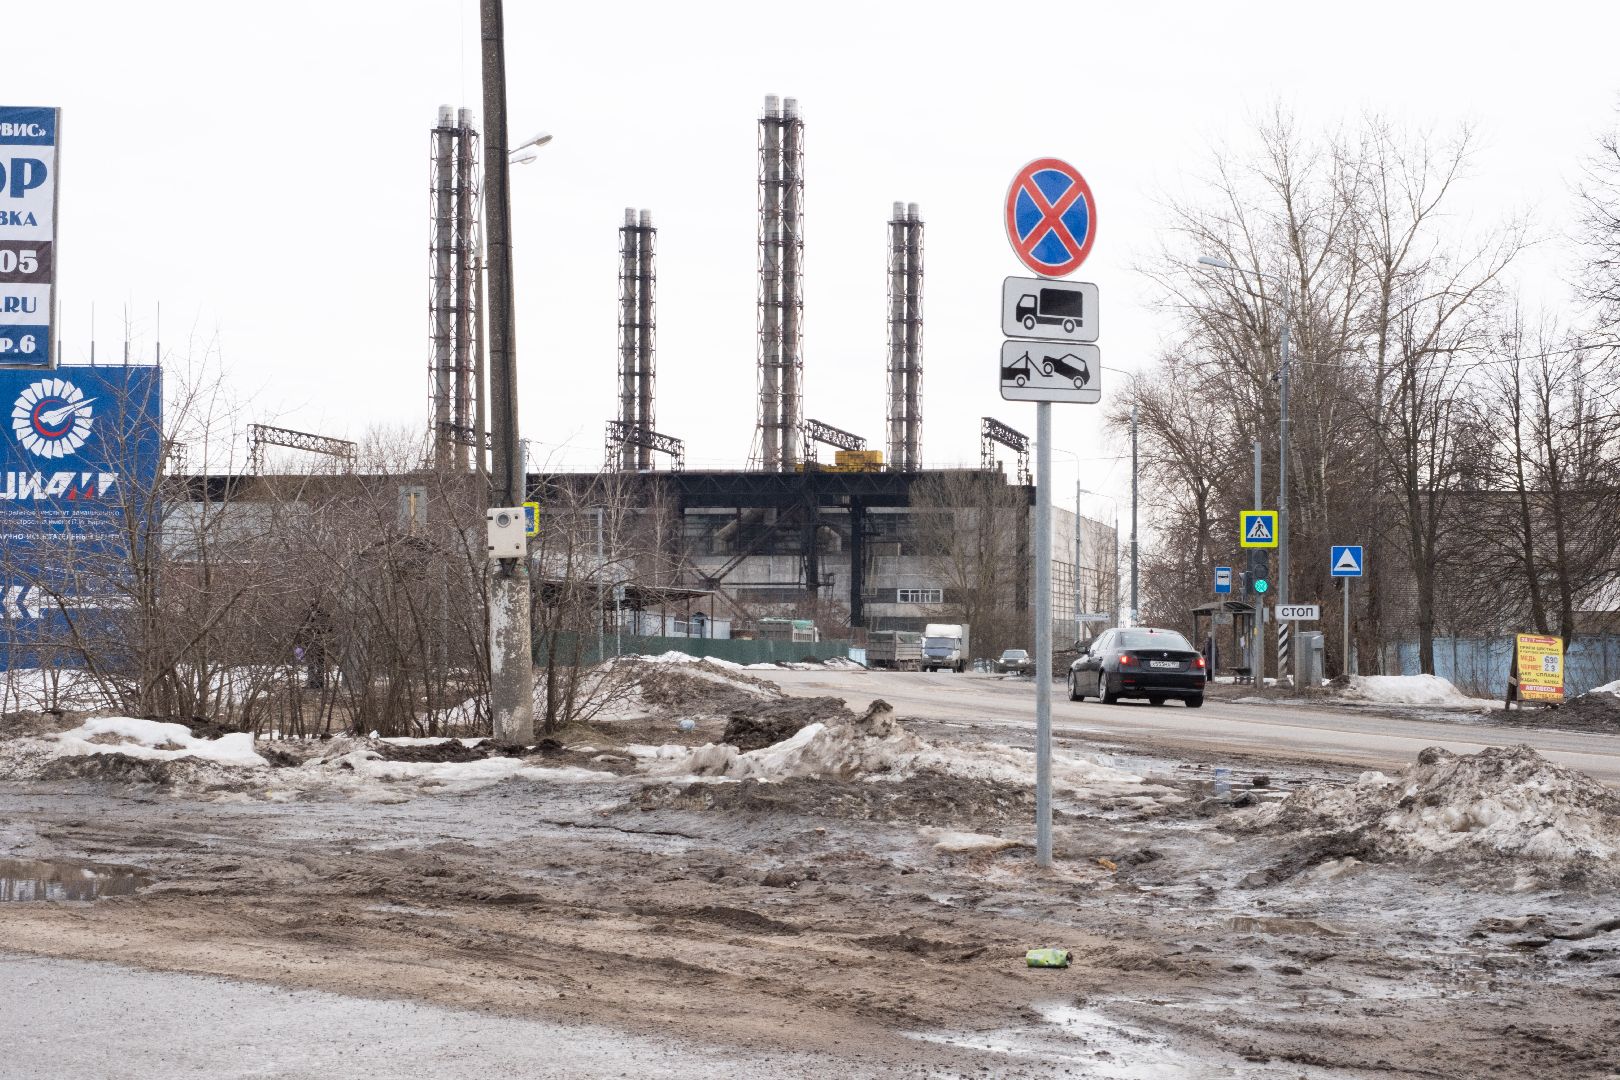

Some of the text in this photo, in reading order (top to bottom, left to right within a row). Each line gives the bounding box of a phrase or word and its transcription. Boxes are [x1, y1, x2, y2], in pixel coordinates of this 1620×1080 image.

[0, 122, 46, 137] ВИС»
[0, 157, 48, 198] Р
[0, 249, 39, 274] 05
[1281, 607, 1314, 617] СТОП
